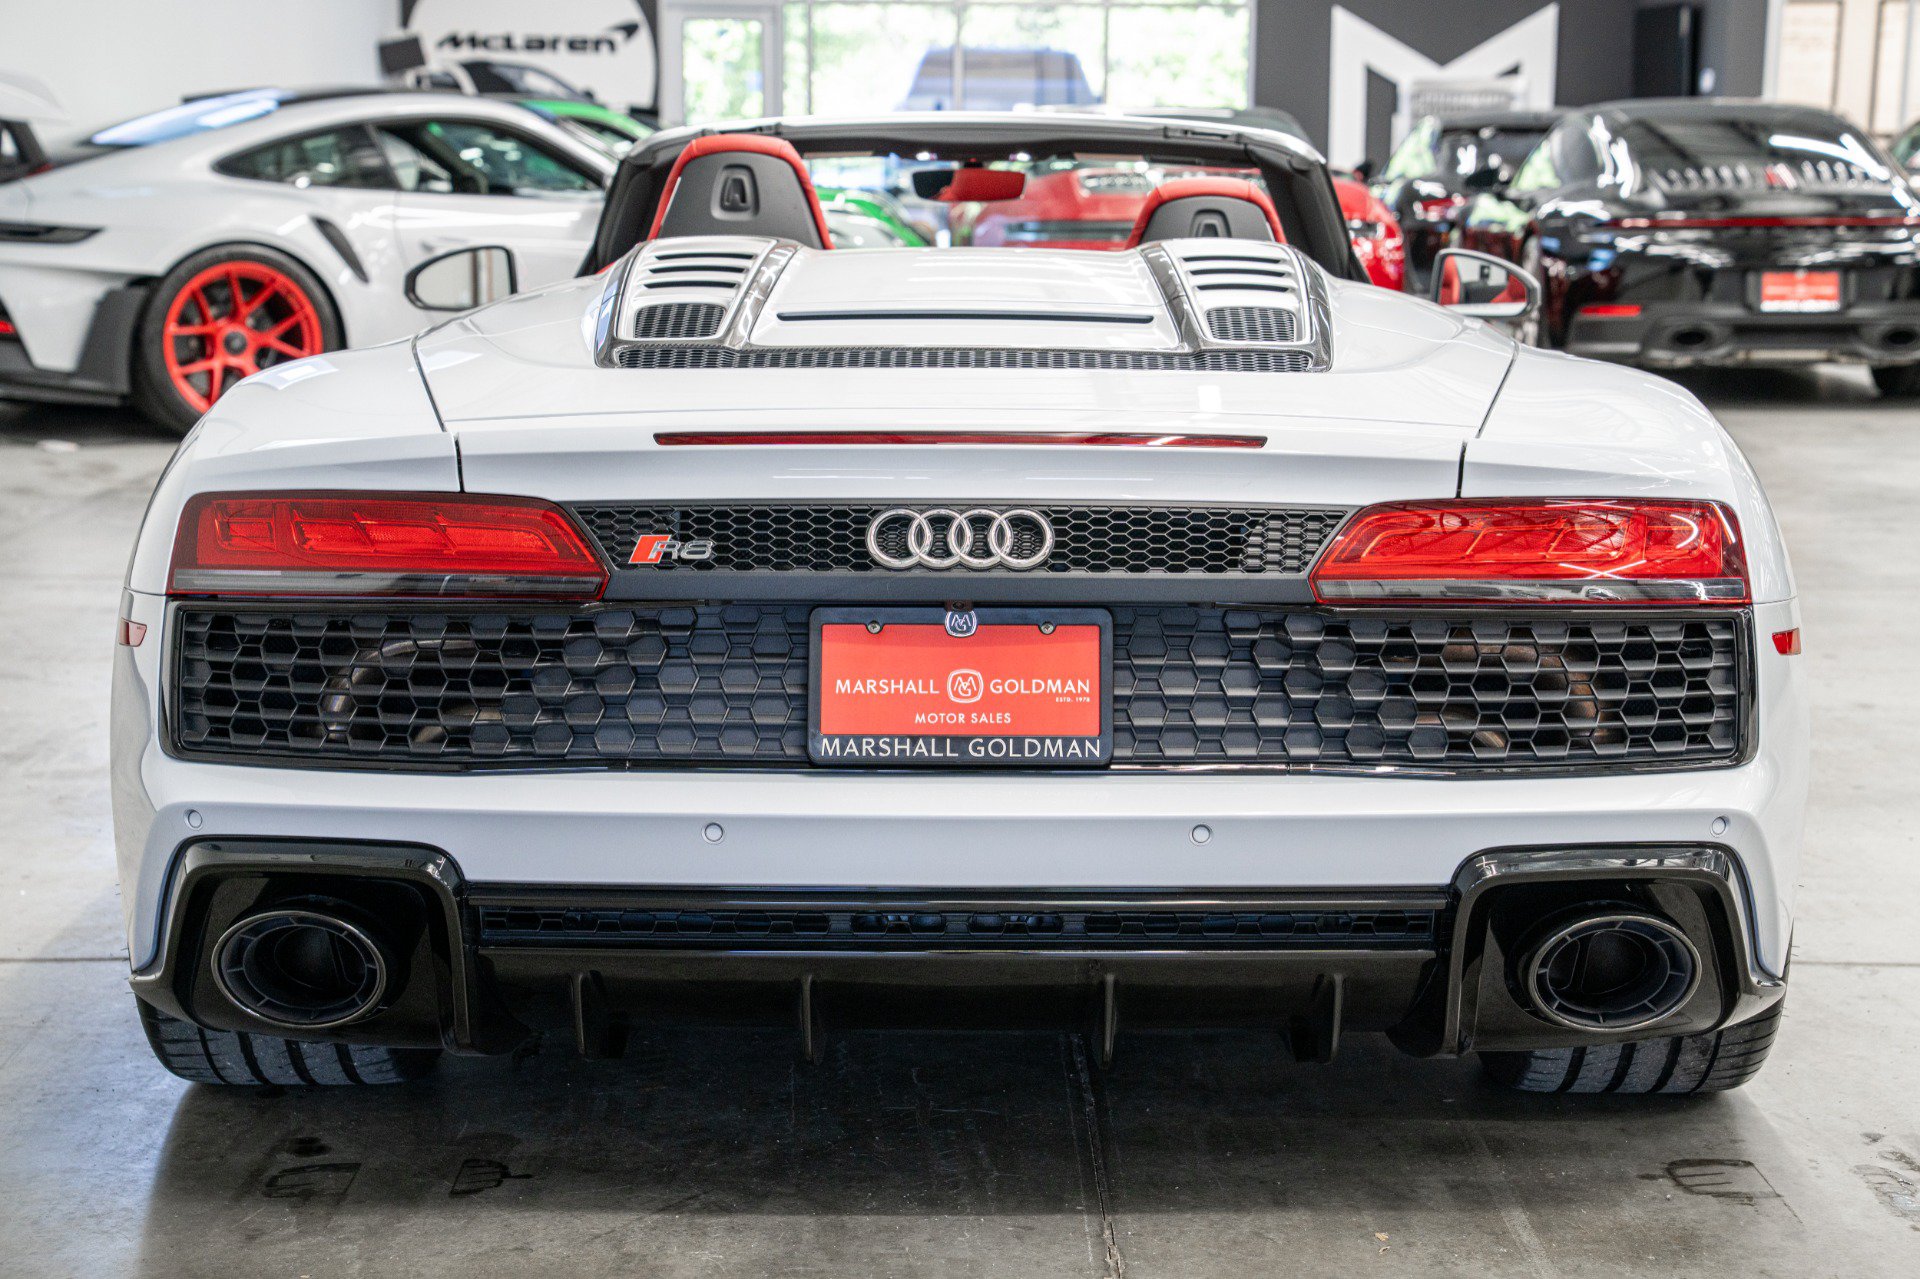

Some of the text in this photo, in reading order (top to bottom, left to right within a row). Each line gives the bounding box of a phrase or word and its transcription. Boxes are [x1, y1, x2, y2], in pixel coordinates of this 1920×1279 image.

[437, 34, 616, 52] McLaren
[835, 679, 940, 694] MARSHALL
[989, 679, 1091, 694] GOLDMAN
[914, 712, 1011, 724] MOTOR SALES
[820, 738, 1101, 759] MARSHALL GOLDMAN
